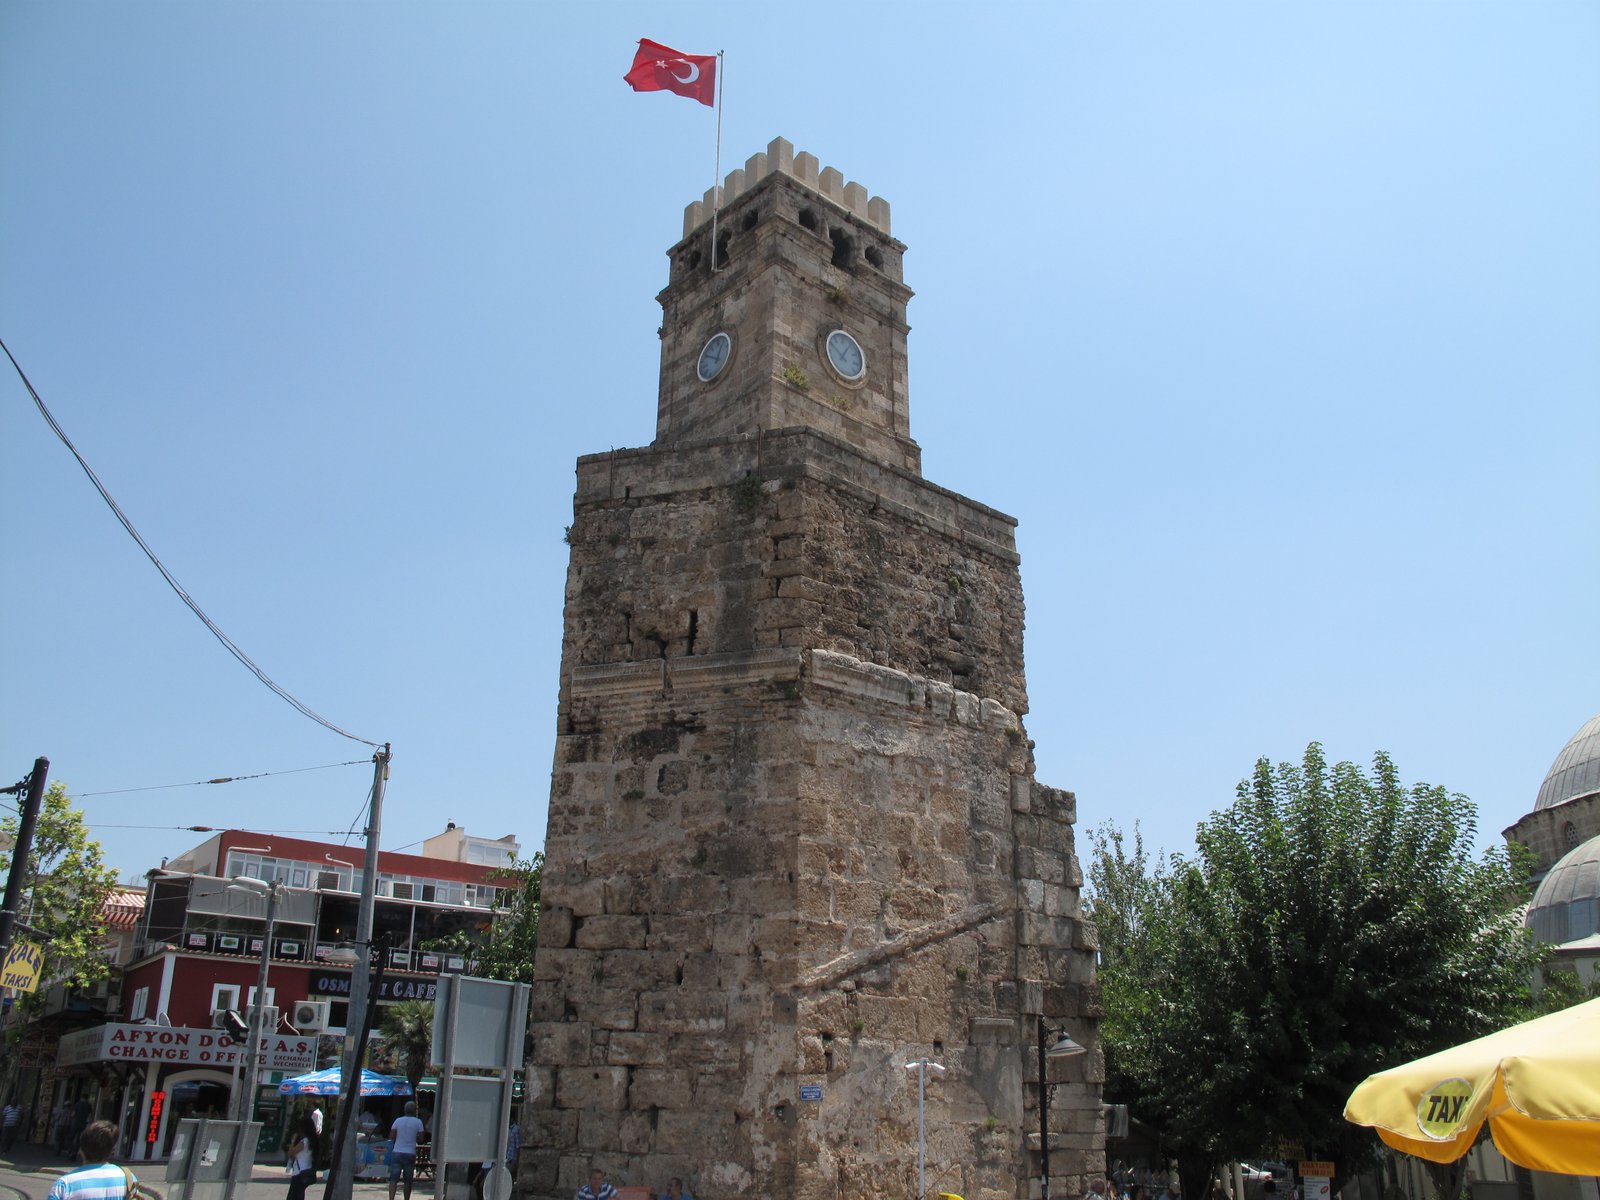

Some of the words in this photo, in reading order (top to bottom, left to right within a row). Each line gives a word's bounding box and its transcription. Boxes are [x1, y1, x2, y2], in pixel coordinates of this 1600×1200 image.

[4, 944, 41, 976] KALE
[111, 1029, 190, 1046] AFYON
[109, 1045, 190, 1060] CHANGE
